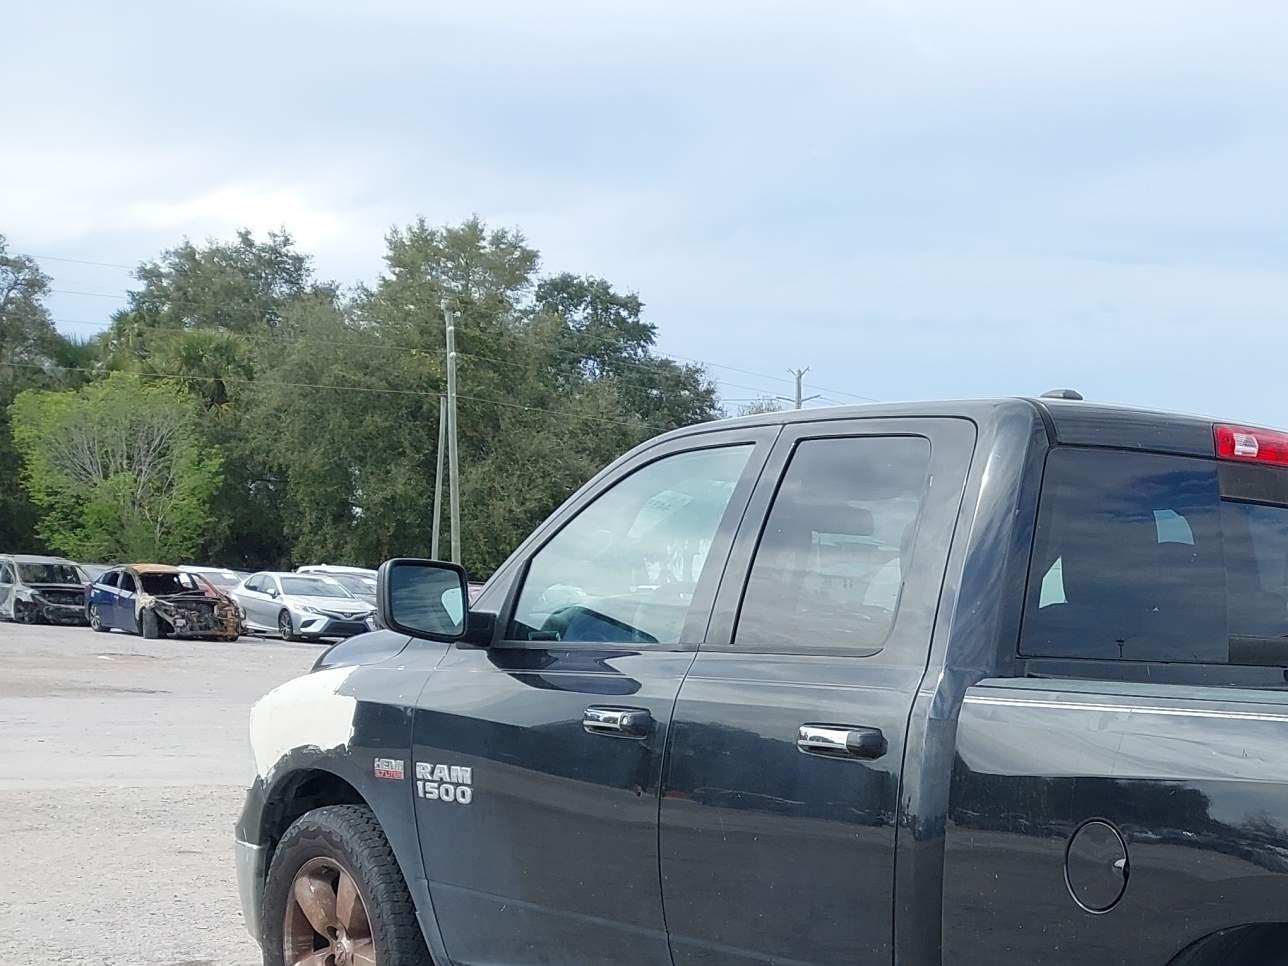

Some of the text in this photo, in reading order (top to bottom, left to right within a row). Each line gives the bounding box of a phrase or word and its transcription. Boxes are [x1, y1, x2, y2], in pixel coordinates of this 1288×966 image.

[374, 758, 404, 770] HEMI
[415, 762, 473, 784] RAM
[416, 781, 473, 804] 1500
